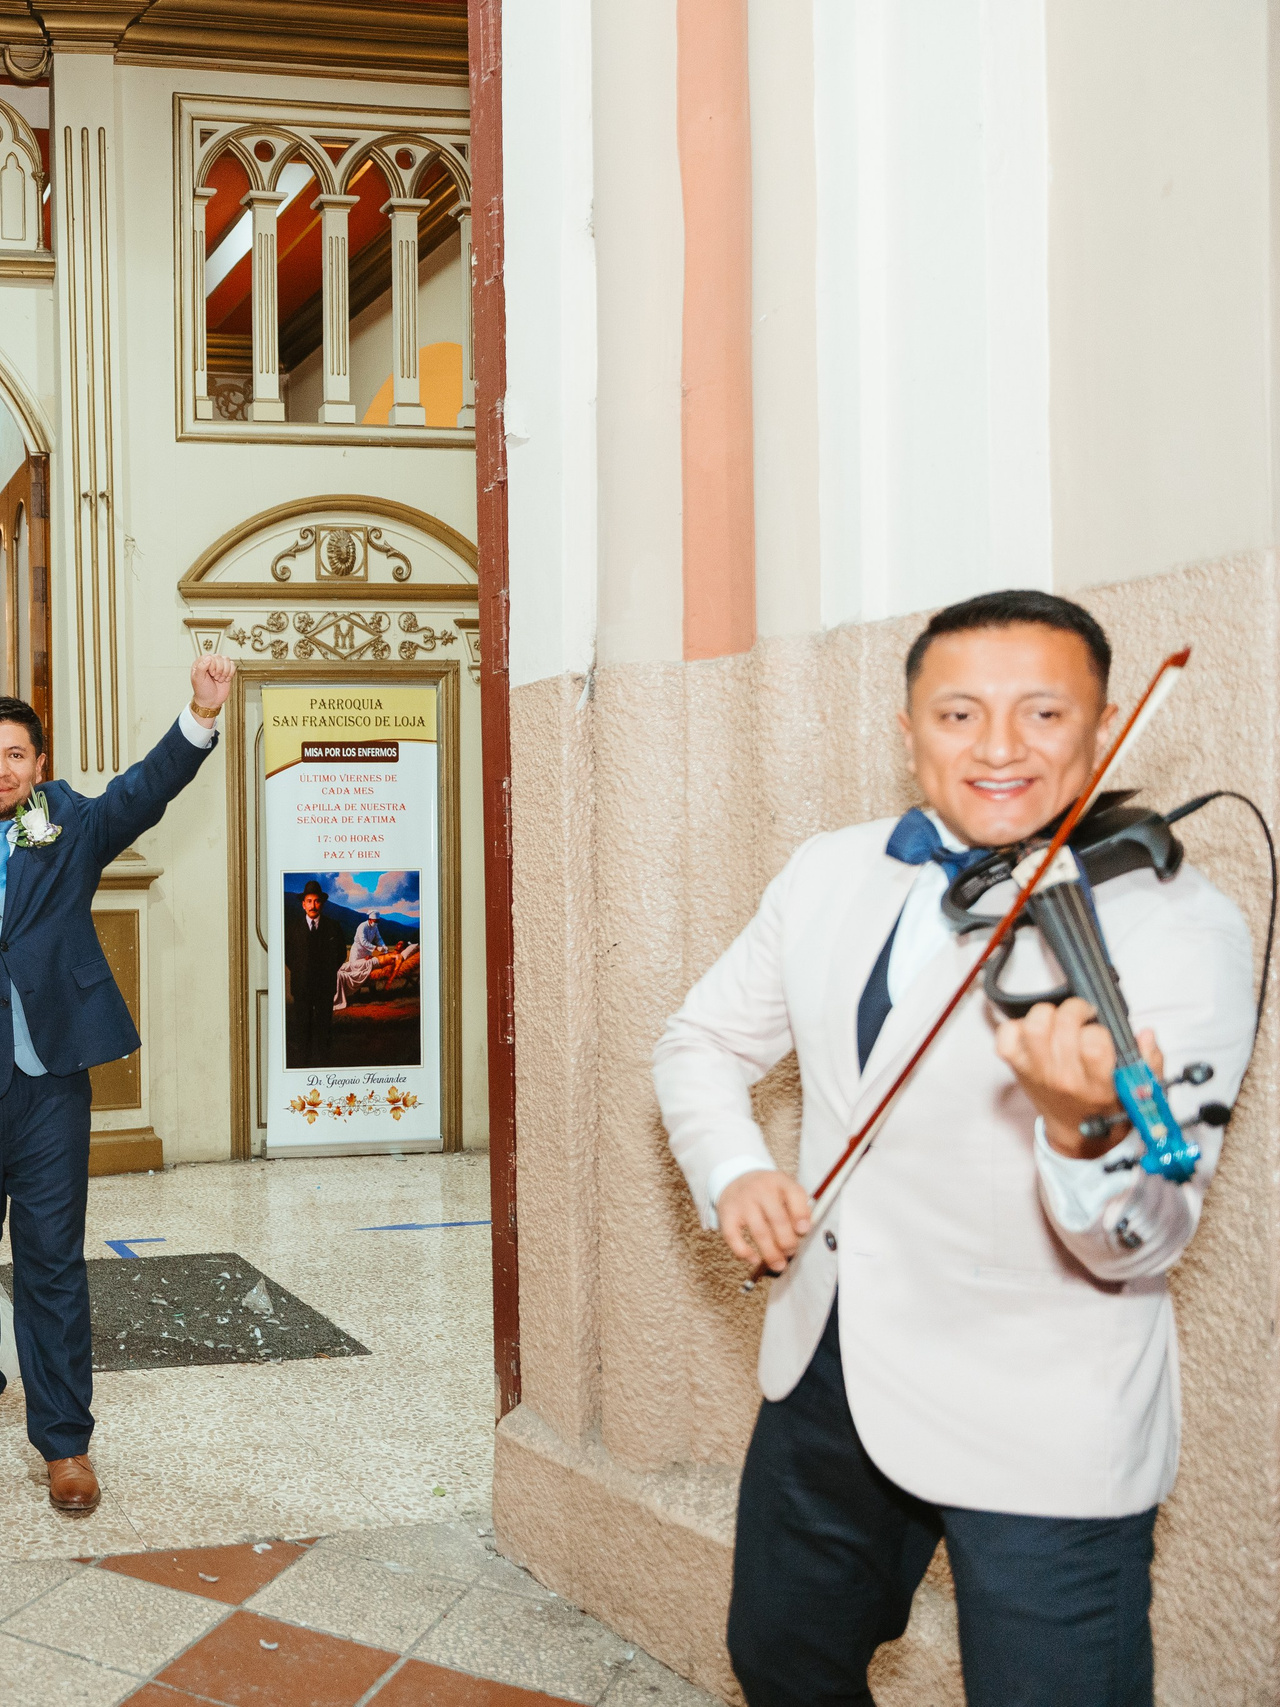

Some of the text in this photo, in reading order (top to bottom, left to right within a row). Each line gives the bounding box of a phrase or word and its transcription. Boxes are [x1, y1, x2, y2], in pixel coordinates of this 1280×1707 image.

[310, 698, 384, 710] PARROQUIA
[272, 715, 426, 728] SAN FRANCISCO DE LOJA
[304, 747, 397, 757] MISA POR LOS ENFERMOS
[339, 773, 382, 783] VIERNES
[384, 774, 398, 783] DE
[321, 786, 375, 795] CADA MES
[296, 802, 407, 812] CAPILLA DE NUESTRA
[296, 814, 396, 824] SEÑORA DE FATIMA
[350, 834, 385, 843] HORAS
[323, 849, 381, 859] PAZ Y BIEN
[306, 1072, 408, 1088] Dr. Gregorio Hernández
